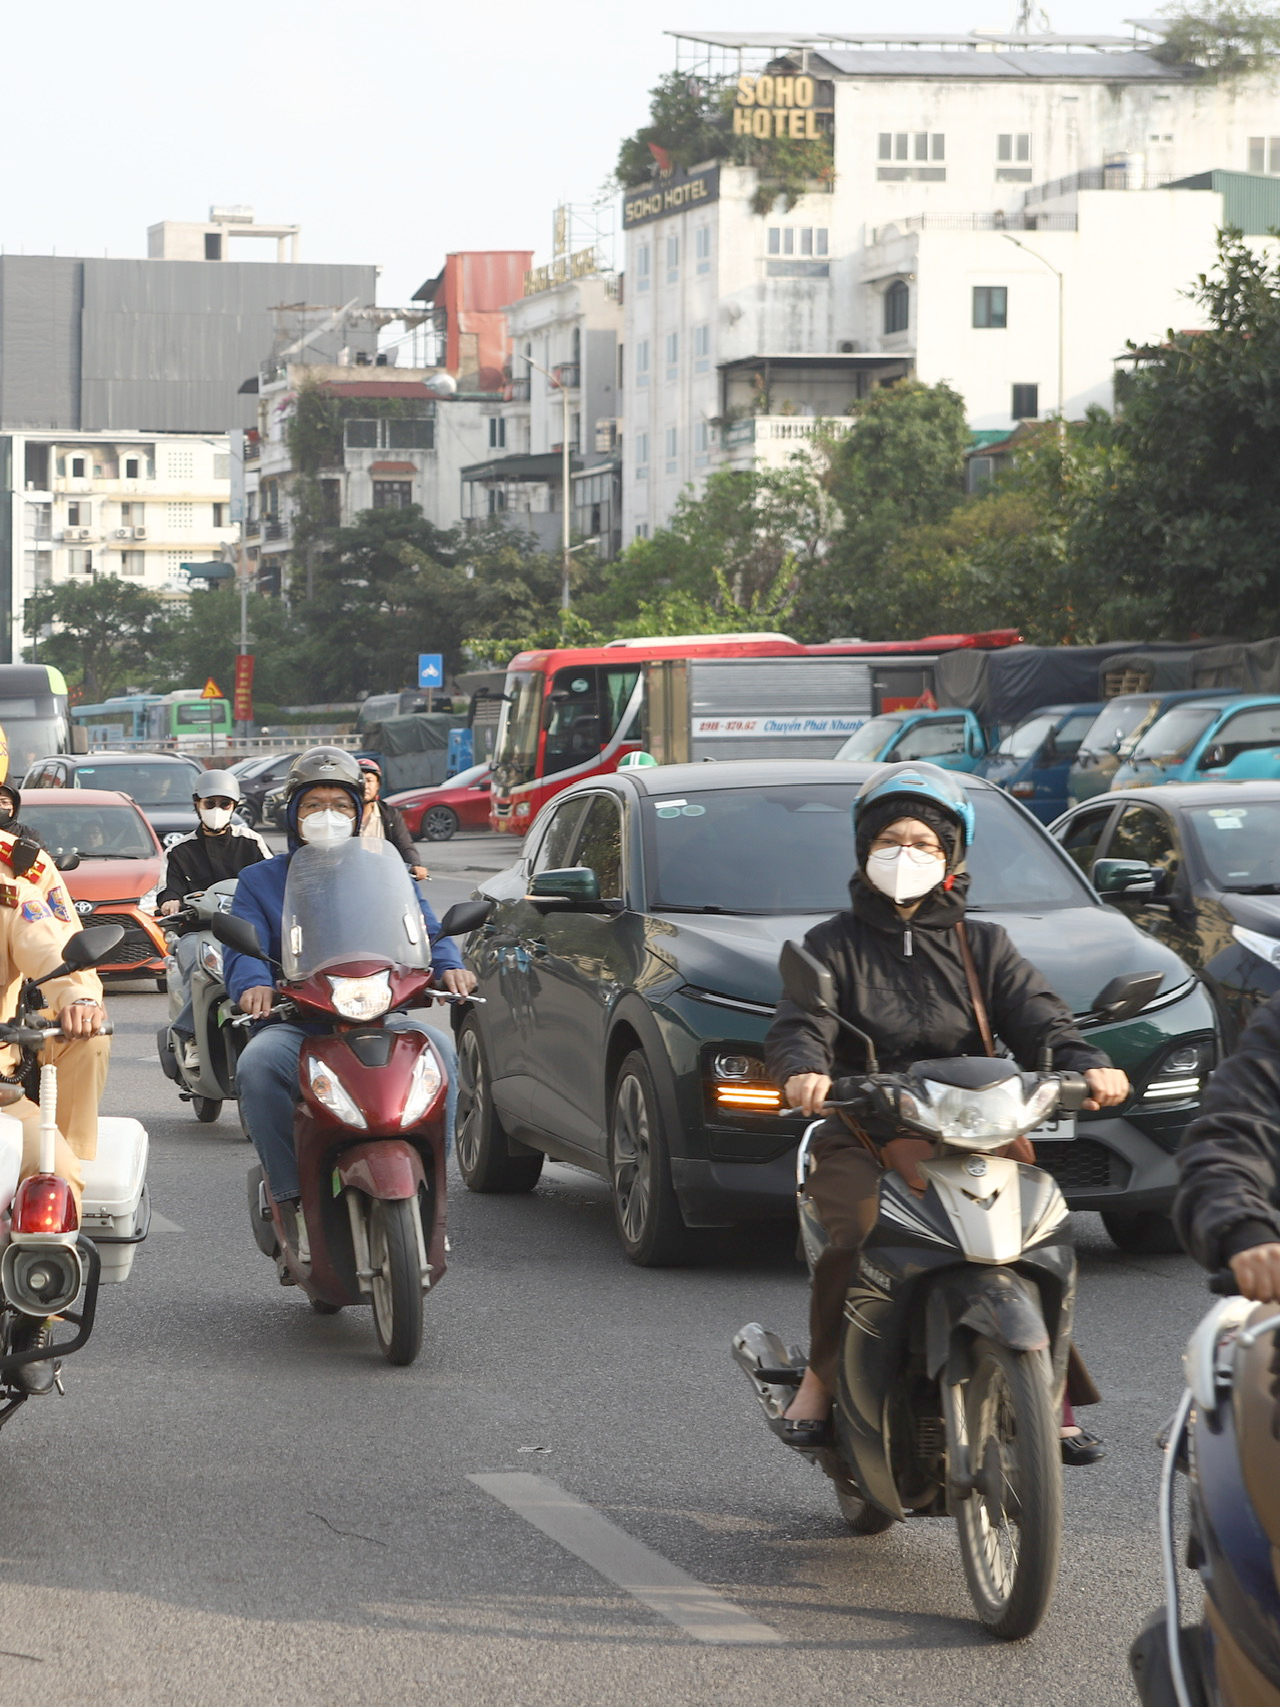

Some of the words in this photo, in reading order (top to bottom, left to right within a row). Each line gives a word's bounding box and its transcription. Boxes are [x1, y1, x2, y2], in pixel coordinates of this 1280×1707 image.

[736, 75, 815, 108] SOHO
[733, 108, 821, 140] HOTEL
[625, 193, 662, 223] SOHO
[664, 178, 709, 209] HOTEL
